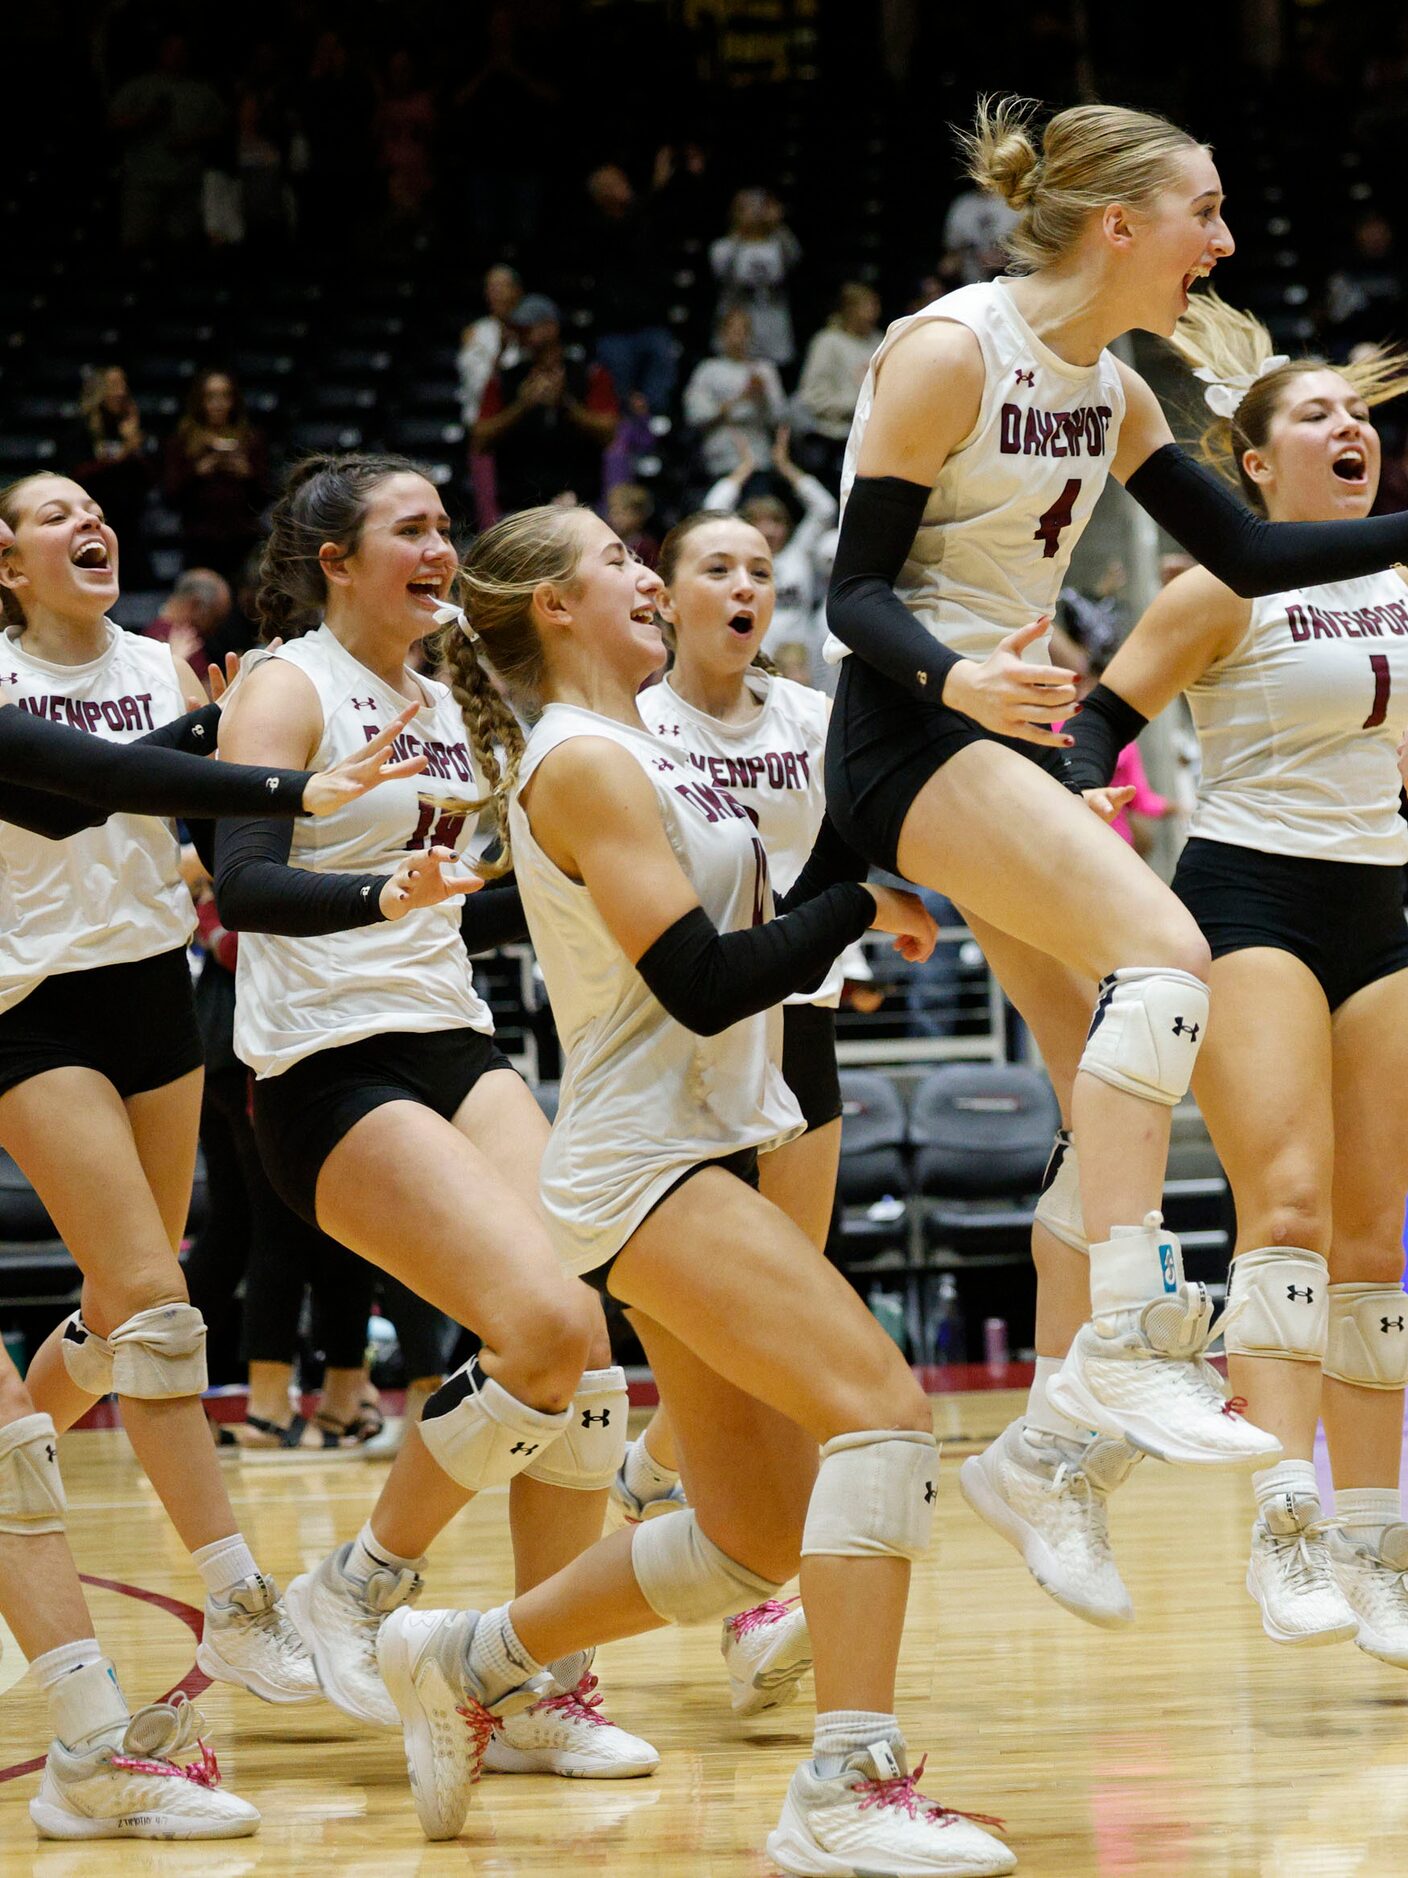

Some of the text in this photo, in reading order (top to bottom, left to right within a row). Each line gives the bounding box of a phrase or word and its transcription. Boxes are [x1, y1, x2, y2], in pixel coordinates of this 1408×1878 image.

[1000, 403, 1113, 458] DAVENPOR
[1033, 478, 1082, 558] 4
[18, 693, 155, 733] AVENPORT
[1362, 654, 1391, 730] 1
[686, 750, 810, 790] VENPORT
